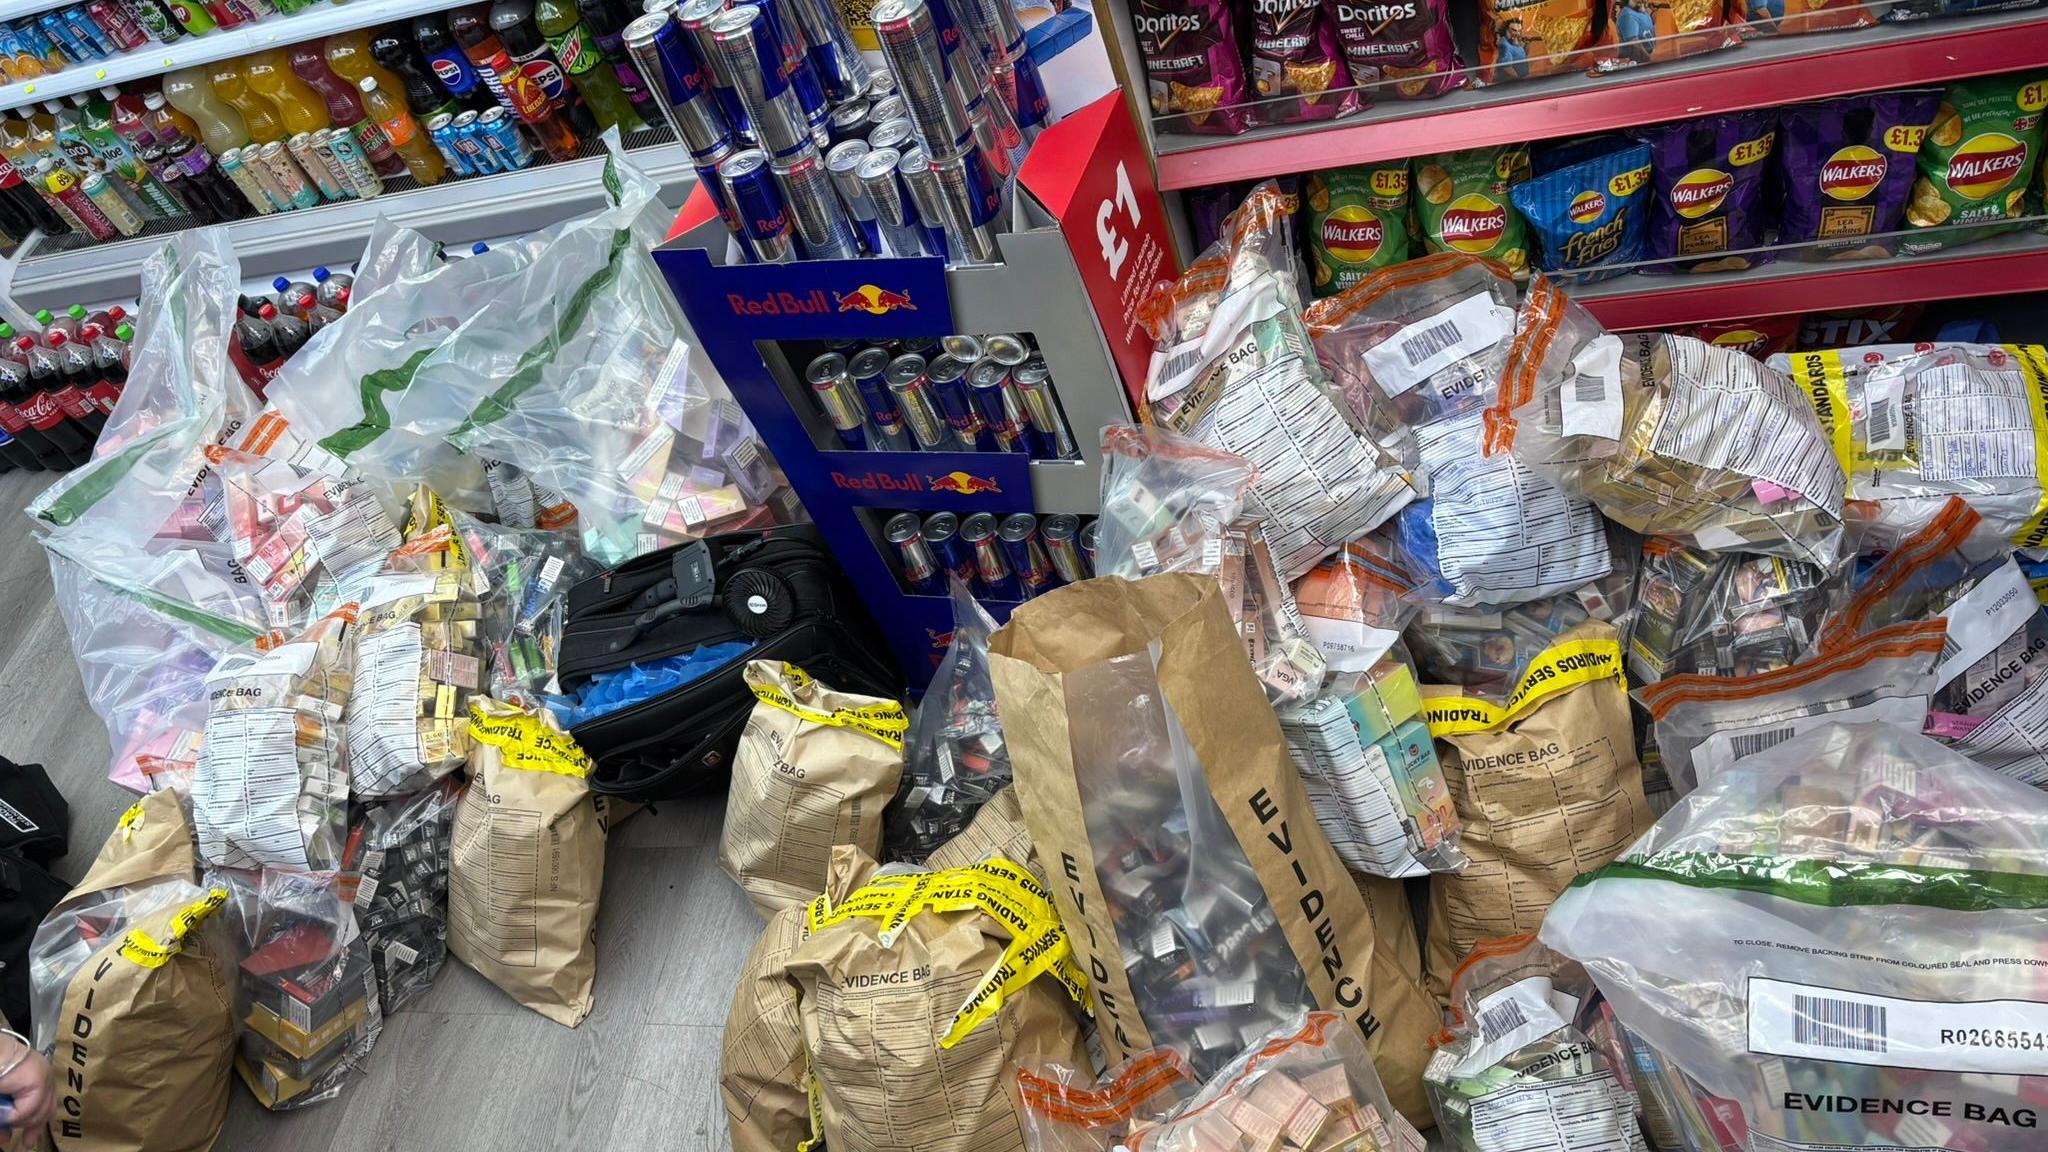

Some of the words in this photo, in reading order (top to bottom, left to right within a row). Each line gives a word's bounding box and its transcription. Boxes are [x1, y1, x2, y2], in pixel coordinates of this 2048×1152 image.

[1135, 13, 1201, 33] Doritos
[1338, 3, 1417, 22] Doritos
[1347, 40, 1421, 55] MINECRAFT
[534, 69, 560, 87] EPSI
[1890, 128, 1924, 147] £1.3
[66, 145, 90, 157] COCO
[102, 146, 123, 161] Aloe
[19, 163, 39, 179] Aloe
[1822, 164, 1886, 183] WALKERS
[1951, 152, 2025, 179] WALKERS
[1672, 181, 1732, 204] WALKERS
[1569, 198, 1604, 217] WALKERS
[1960, 208, 1989, 219] SALT
[1990, 205, 2001, 216] &
[757, 208, 786, 233] Red
[1096, 160, 1141, 281] £1
[1443, 214, 1504, 233] WALKERS
[1324, 225, 1382, 242] WALKERS
[1120, 265, 1137, 307] Limited
[1134, 233, 1151, 269] Launch
[1339, 271, 1361, 281] SALT
[1123, 298, 1135, 325] Price
[1138, 259, 1150, 283] Red
[1229, 341, 1259, 365] BAG
[1441, 369, 1485, 400] EVIDE
[1805, 353, 1836, 437] STANDARDS
[228, 557, 248, 585] BAG
[1953, 661, 2023, 715] EVIDENCE
[2023, 638, 2047, 665] BAG
[235, 687, 262, 698] BAG
[1461, 751, 1526, 773] VIDENCE
[1527, 742, 1560, 763] BAG
[780, 764, 807, 780] BAG
[976, 893, 1029, 932] RADING
[1249, 786, 1382, 1042] EVIDENCE
[1019, 927, 1061, 965] SERVICE
[1061, 851, 1133, 1049] EVIDEN
[1775, 942, 1811, 955] REMOVE
[1811, 947, 1849, 959] BACKING
[1849, 952, 1875, 962] STRIP
[1875, 956, 1901, 966] FROM
[1901, 960, 1949, 970] COLOURED
[1949, 959, 1973, 969] SEAL
[1972, 957, 1992, 966] AND
[1991, 957, 2023, 966] PRESS
[912, 963, 932, 982] BAG
[962, 962, 1018, 1015] TRADING
[62, 950, 117, 1139] VIDENCE
[1940, 1028, 2048, 1052] R0266554
[1514, 1044, 1581, 1079] VIDENCE
[1581, 1041, 1598, 1056] BA
[1783, 1091, 1953, 1118] EVIDENCE
[1963, 1103, 2039, 1129] BAG
